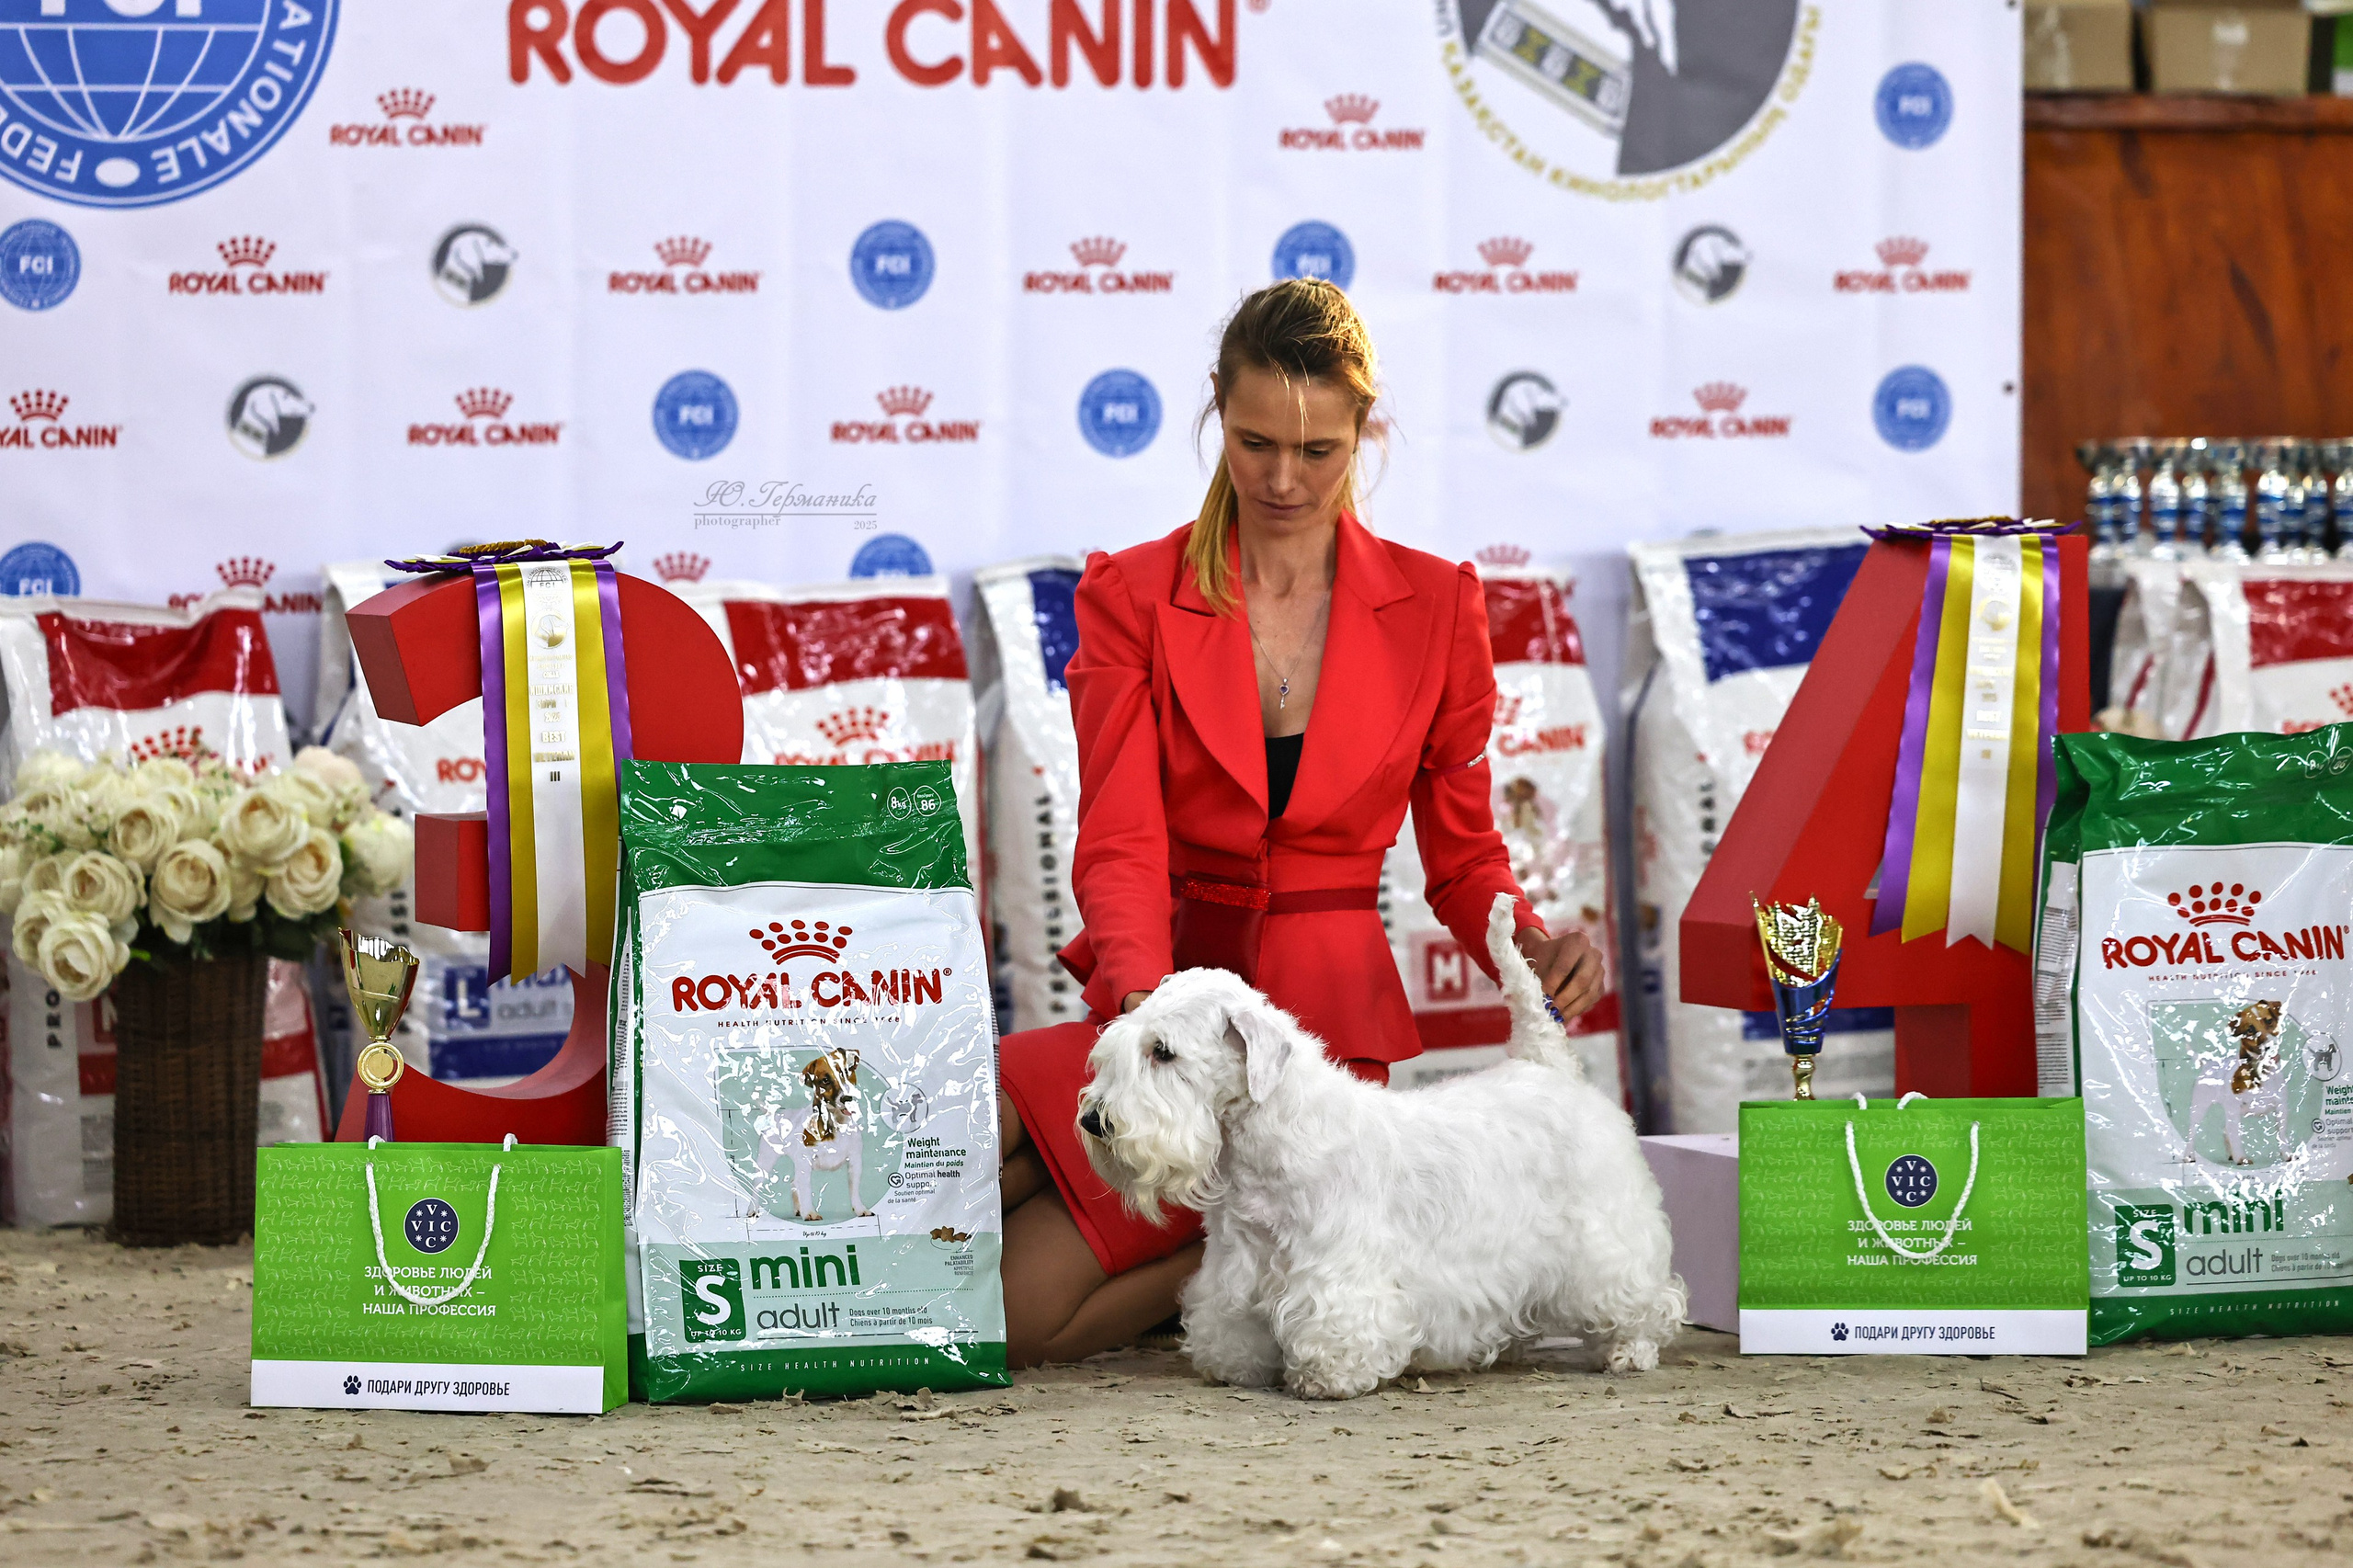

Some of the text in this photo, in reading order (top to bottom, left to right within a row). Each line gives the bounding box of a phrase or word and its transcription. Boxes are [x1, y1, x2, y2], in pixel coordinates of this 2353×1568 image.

[508, 0, 1238, 89] ROYAL CANIN
[1897, 96, 1931, 116] FCI
[330, 126, 483, 146] ROYAL CANIN
[1280, 129, 1424, 149] ROYAL CANIN
[19, 255, 53, 275] FCI
[875, 255, 911, 274] FCI
[169, 273, 324, 294] ROYAL CANIN
[608, 272, 758, 293] ROYAL CANIN
[1024, 272, 1172, 292] ROYAL CANIN
[1433, 272, 1577, 292] ROYAL CANIN
[1834, 271, 1969, 291] ROYAL CANIN
[679, 404, 714, 424] FCI
[1103, 404, 1140, 423] FCI
[1896, 399, 1929, 418] FCI
[407, 424, 560, 446] ROYAL CANIN
[831, 420, 979, 442] ROYAL CANIN
[1650, 416, 1790, 437] ROYAL CANIN
[40, 426, 117, 449] CANIN
[264, 593, 322, 613] ANIN
[541, 731, 567, 744] BEST
[921, 799, 936, 811] 86
[2101, 932, 2225, 970] ROYAL
[2231, 926, 2345, 961] CANIN
[1433, 952, 1464, 991] M
[672, 969, 943, 1012] ROYAL CANIN
[717, 1019, 759, 1028] HEALTH
[907, 1136, 940, 1149] Weight
[905, 1148, 967, 1159] maintenance
[945, 1159, 964, 1167] poids
[904, 1169, 961, 1181] Optimal health
[905, 1180, 938, 1189] suppo
[915, 1188, 936, 1197] optimal
[2132, 1209, 2157, 1218] SIZE
[2183, 1188, 2285, 1234] mini
[1857, 1237, 1869, 1248] И
[2129, 1220, 2164, 1271] S
[697, 1264, 723, 1273] SIZE
[749, 1244, 860, 1290] mini
[1847, 1255, 1978, 1266] НАША ПРОФЕССИЯ
[2187, 1247, 2263, 1276] adult
[374, 1284, 384, 1296] И
[695, 1275, 732, 1325] S
[363, 1303, 496, 1316] НАША ПРОФЕССИЯ
[756, 1301, 840, 1329] adult
[848, 1308, 865, 1316] Dogs
[882, 1307, 890, 1315] 10
[2169, 1300, 2339, 1315] SIZE HEALTH NUTRITION
[850, 1316, 933, 1327] Chiens à partir de 10 mois
[1854, 1324, 1995, 1342] ПОДАРИ ДРУГУ ЗДОРОВЬЕ
[740, 1358, 929, 1371] SIZE HEALTH NUTRITION
[367, 1378, 511, 1398] ПОДАРИ ДРУГУ ЗДОРОВЬЕ
